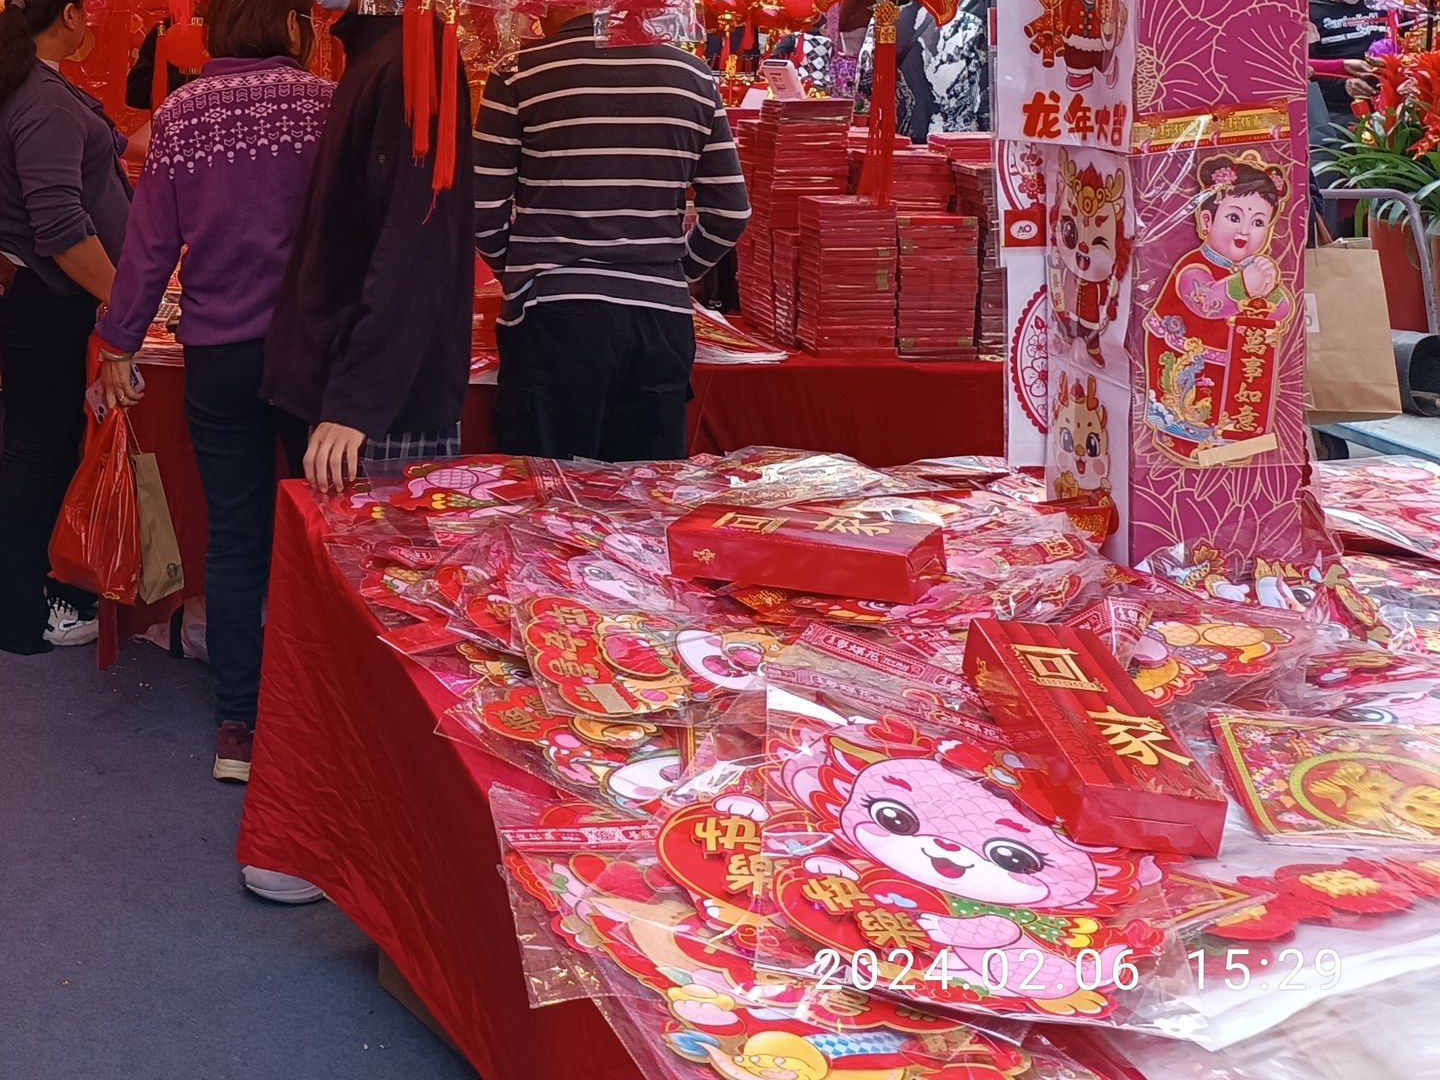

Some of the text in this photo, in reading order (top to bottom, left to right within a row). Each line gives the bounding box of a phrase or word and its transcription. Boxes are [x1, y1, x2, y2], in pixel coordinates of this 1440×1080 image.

[1230, 328, 1268, 431] 萬事如意
[803, 877, 932, 950] 快樂
